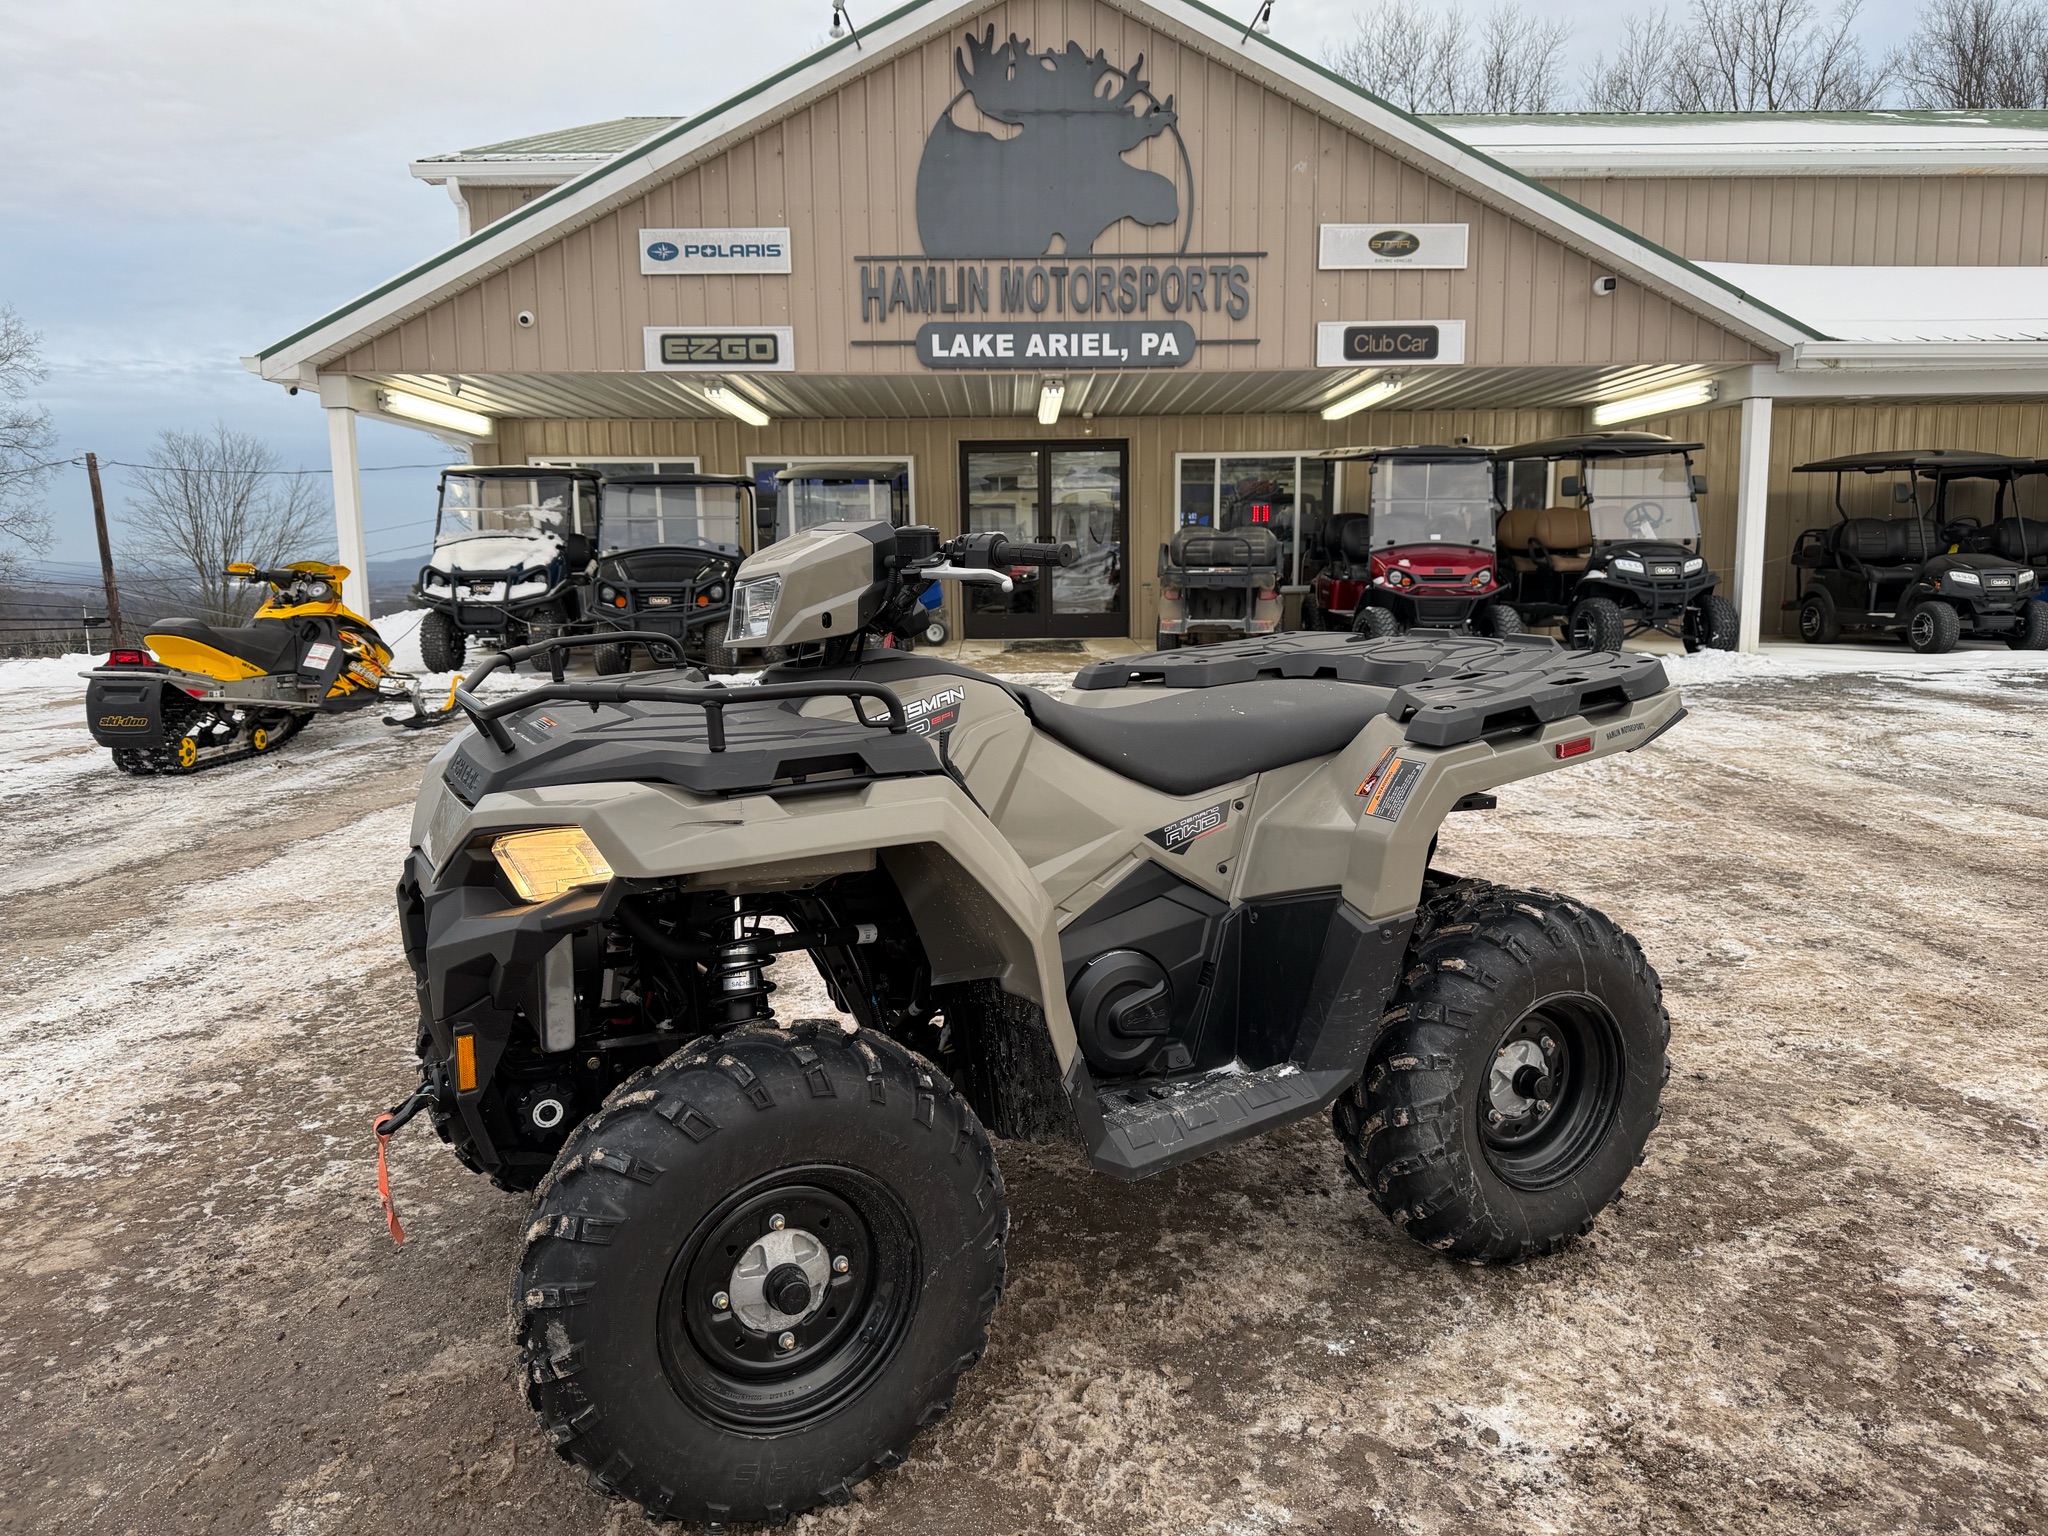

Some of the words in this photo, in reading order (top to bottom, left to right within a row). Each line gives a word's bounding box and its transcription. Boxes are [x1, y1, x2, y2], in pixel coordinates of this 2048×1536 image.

[685, 244, 782, 258] POLARIS
[1371, 240, 1411, 249] STAR
[861, 265, 989, 323] HAMLIN
[1000, 264, 1249, 321] MOTORSPORTS
[931, 333, 1015, 358] LAKE
[1025, 333, 1128, 362] ARIEL,
[1141, 332, 1180, 357] PA
[1353, 334, 1395, 353] Club
[1396, 333, 1429, 352] Car
[348, 660, 381, 685] ski-doo
[99, 716, 148, 727] ski-doo
[931, 711, 954, 725] EFI
[1164, 823, 1177, 833] ON
[1180, 806, 1219, 826] DEMAND
[1165, 812, 1220, 846] AWD
